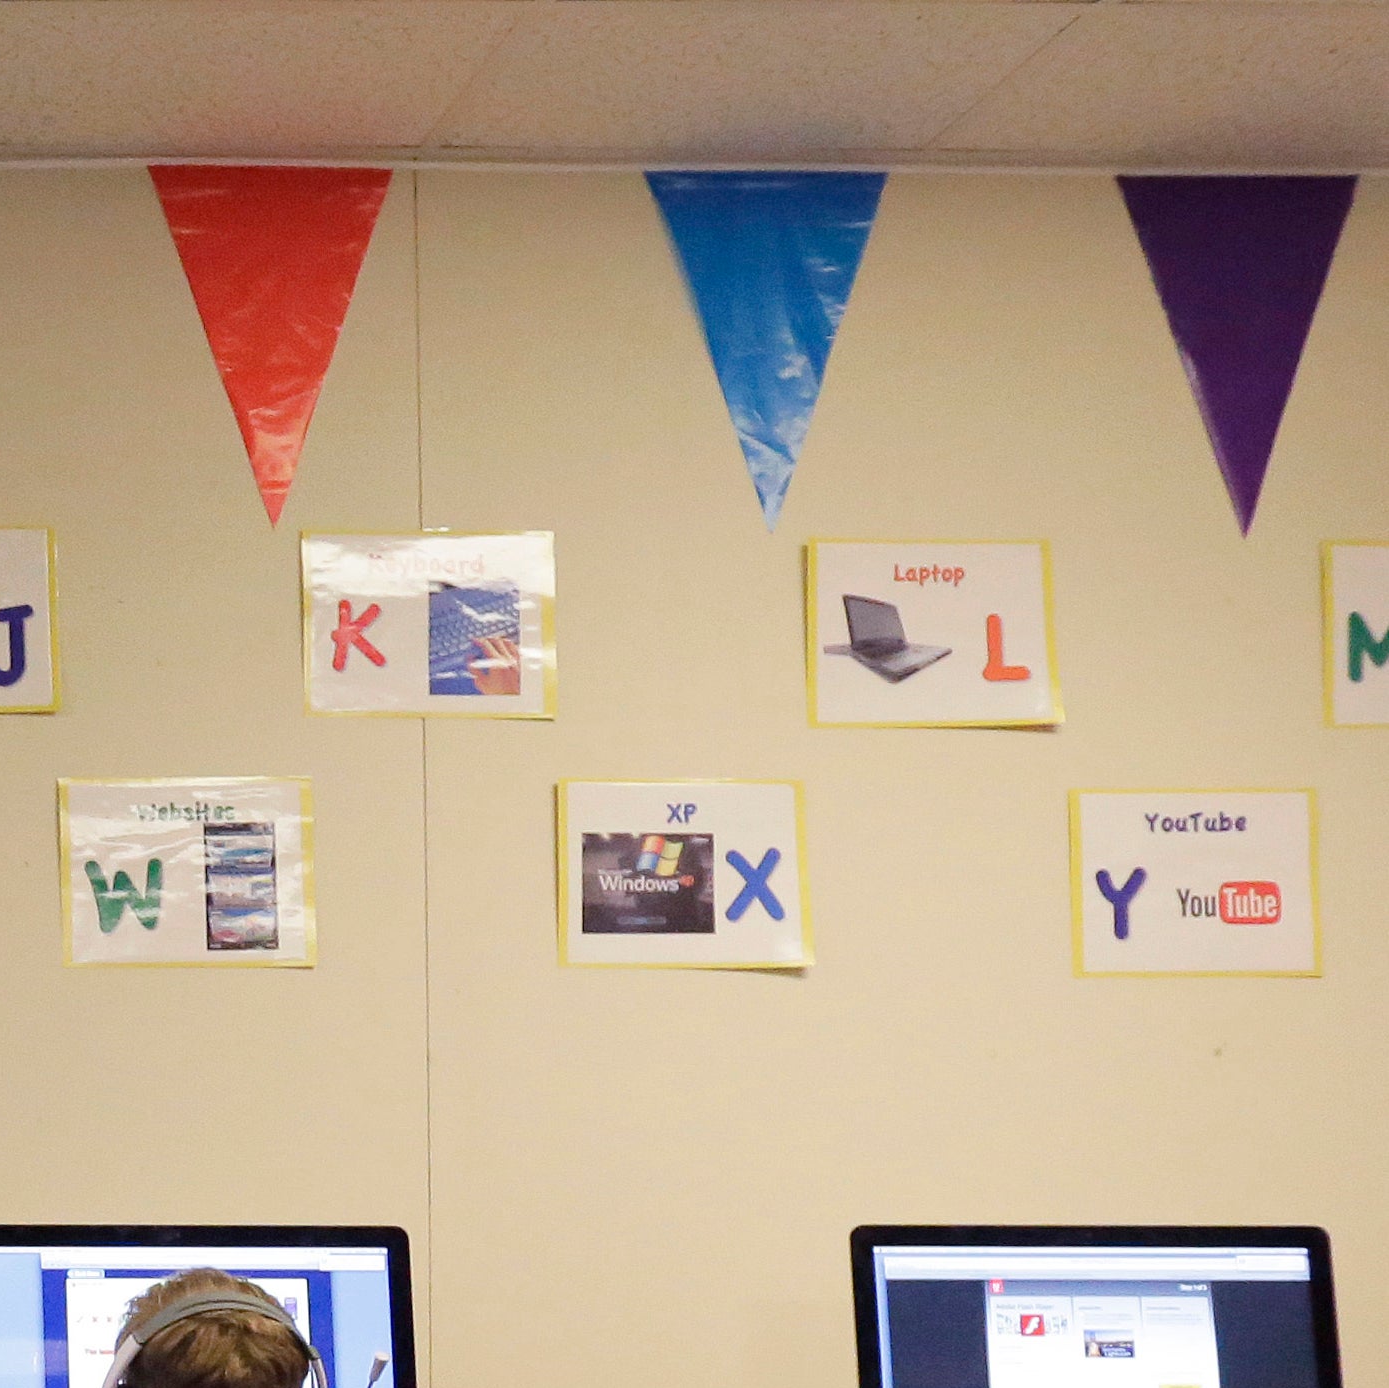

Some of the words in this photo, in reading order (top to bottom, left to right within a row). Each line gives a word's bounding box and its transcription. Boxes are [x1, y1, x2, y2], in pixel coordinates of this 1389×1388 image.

[893, 563, 965, 588] Laptop
[331, 599, 387, 672] K
[982, 613, 1031, 681] L
[666, 803, 697, 824] XP
[1145, 811, 1247, 832] YouTube
[84, 858, 163, 933] W
[598, 874, 680, 893] Windows
[725, 847, 786, 923] X
[1095, 867, 1147, 940] Y
